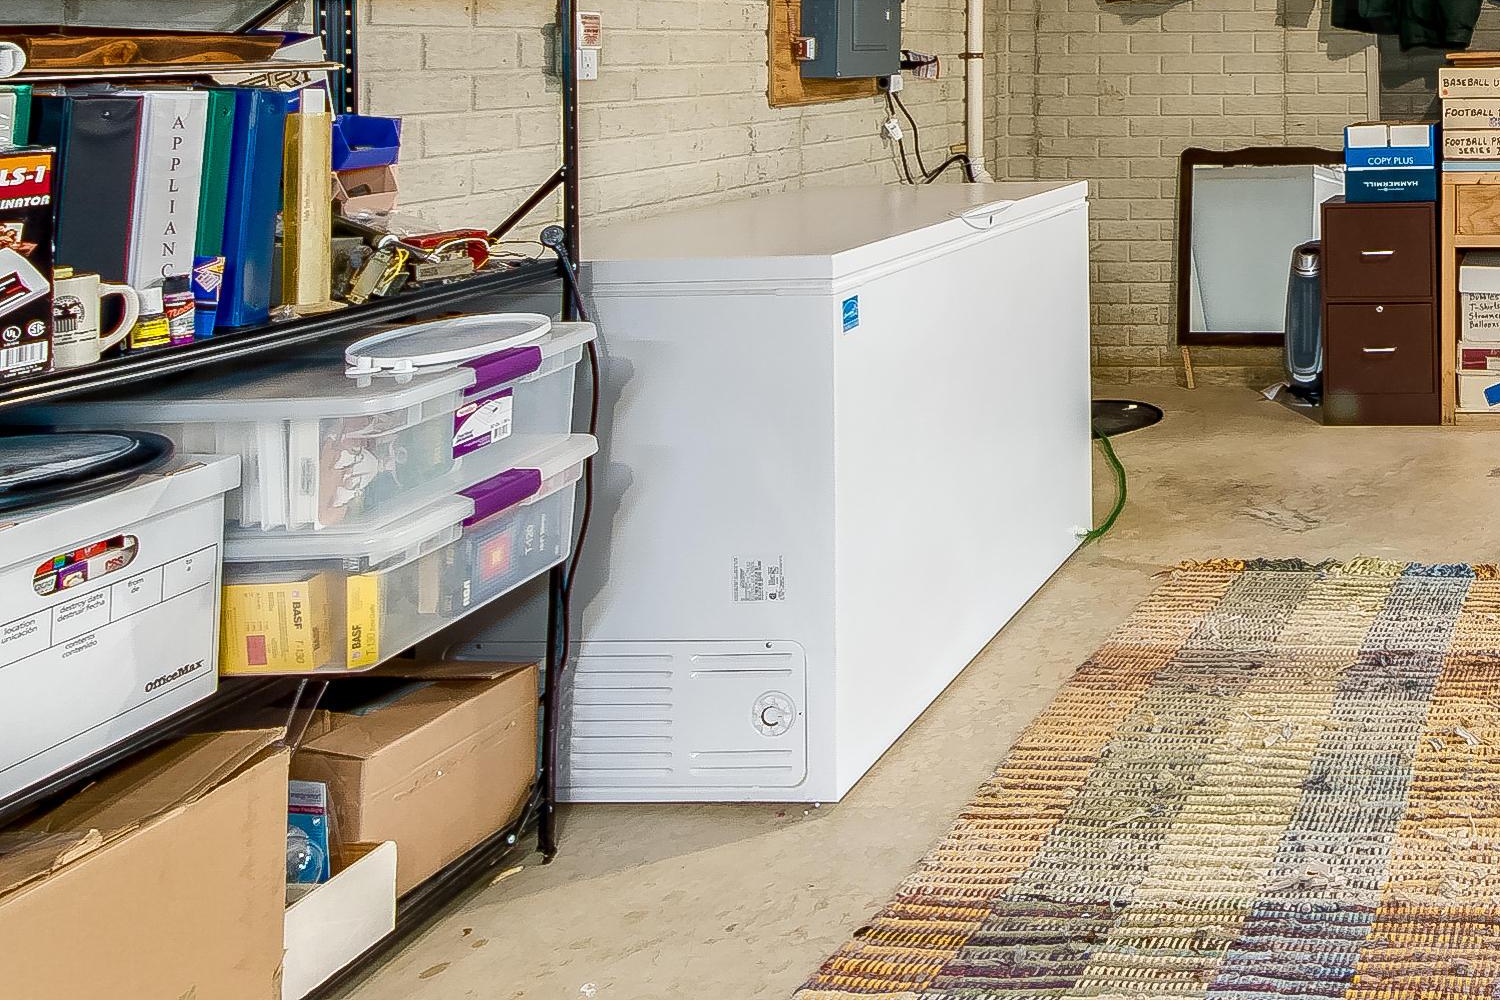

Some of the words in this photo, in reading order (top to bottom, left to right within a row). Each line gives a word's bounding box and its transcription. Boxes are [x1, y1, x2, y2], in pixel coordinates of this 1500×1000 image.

[1442, 78, 1490, 88] BASEBALL
[1444, 107, 1494, 118] FOOTBALL
[1444, 137, 1488, 147] FOOTBALL
[1458, 147, 1491, 155] SERIES
[1367, 157, 1393, 165] COPY
[1393, 156, 1414, 165] PLUS
[1362, 180, 1419, 188] HAMMERMILL
[127, 576, 145, 589] from
[291, 601, 303, 630] BASF
[3, 618, 36, 636] location
[351, 624, 363, 650] BASF
[61, 639, 98, 659] contenido
[144, 659, 205, 693] OfficeMax
